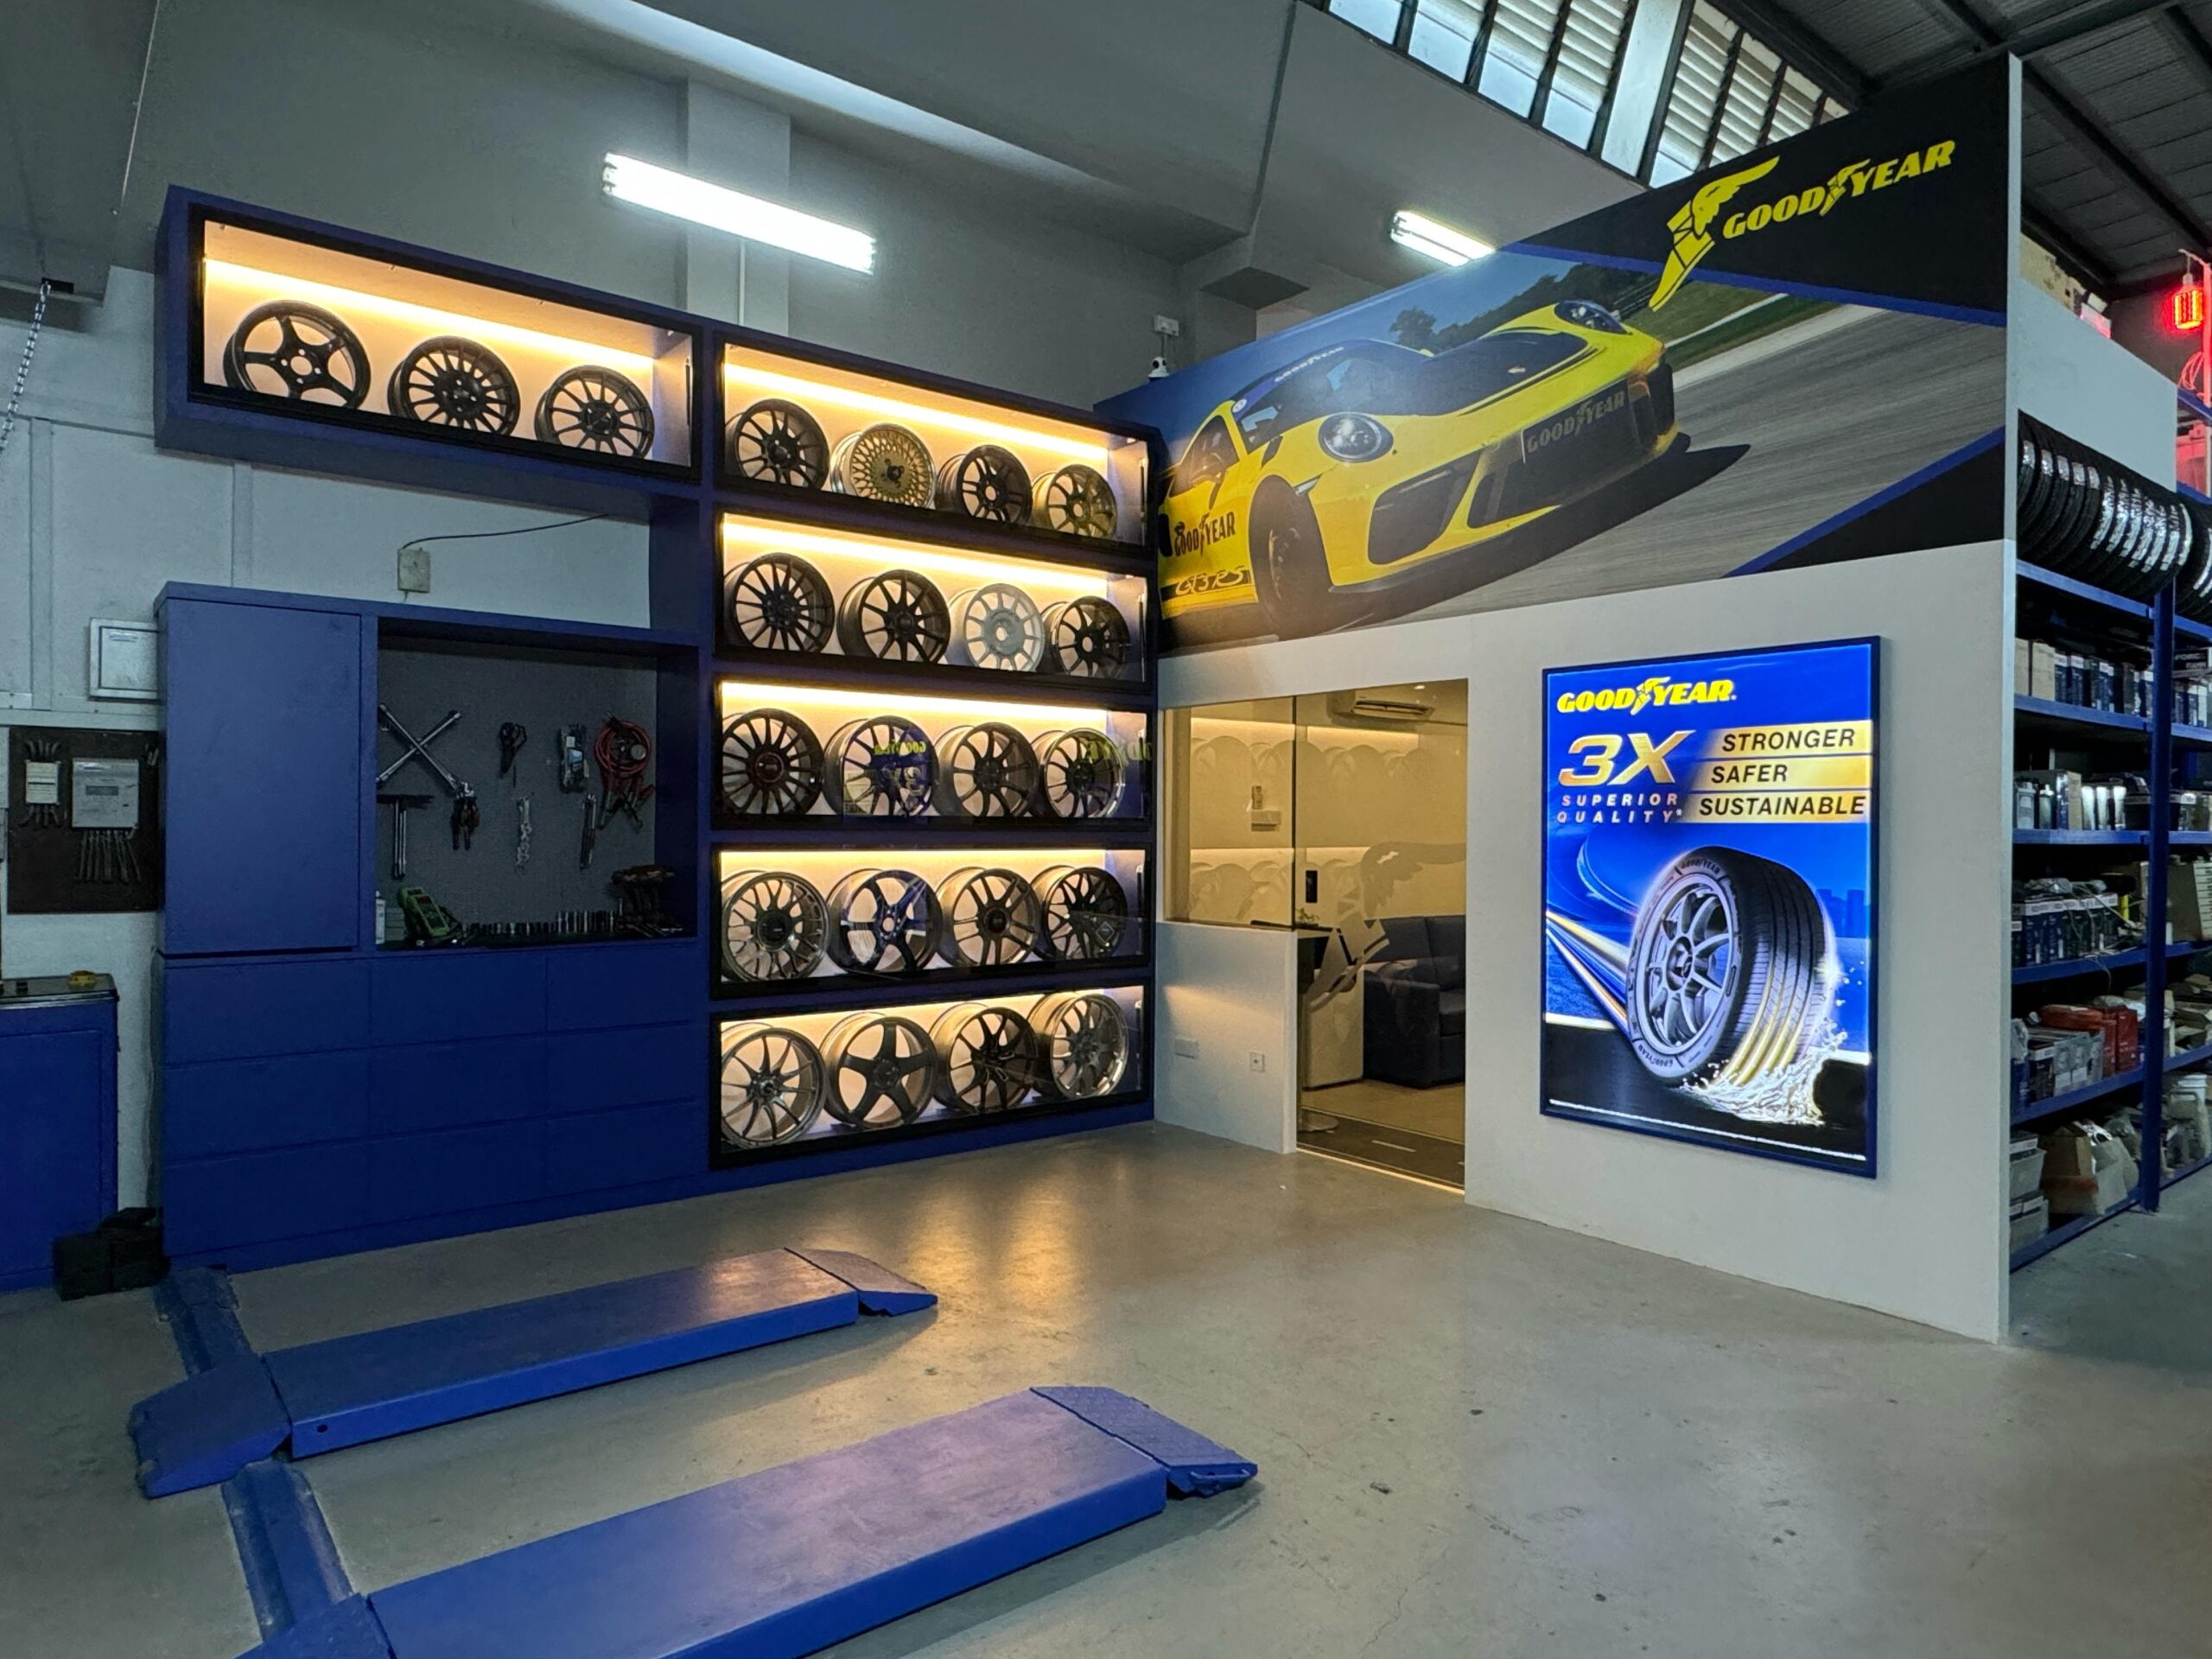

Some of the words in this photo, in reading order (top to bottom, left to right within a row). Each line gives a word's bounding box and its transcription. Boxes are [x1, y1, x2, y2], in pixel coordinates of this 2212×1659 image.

[1722, 139, 1955, 239] GOODYEAR
[1527, 391, 1624, 454] GOODYEAR
[1173, 511, 1236, 557] GOODYEAR
[1556, 677, 1734, 715] GOODYEAR
[1559, 729, 1697, 786] 3X
[1722, 728, 1855, 752] STRONGER
[1711, 764, 1788, 784] SAFER
[1561, 792, 1678, 807] SUPERIOR
[1699, 796, 1866, 816] SUSTAINABLE
